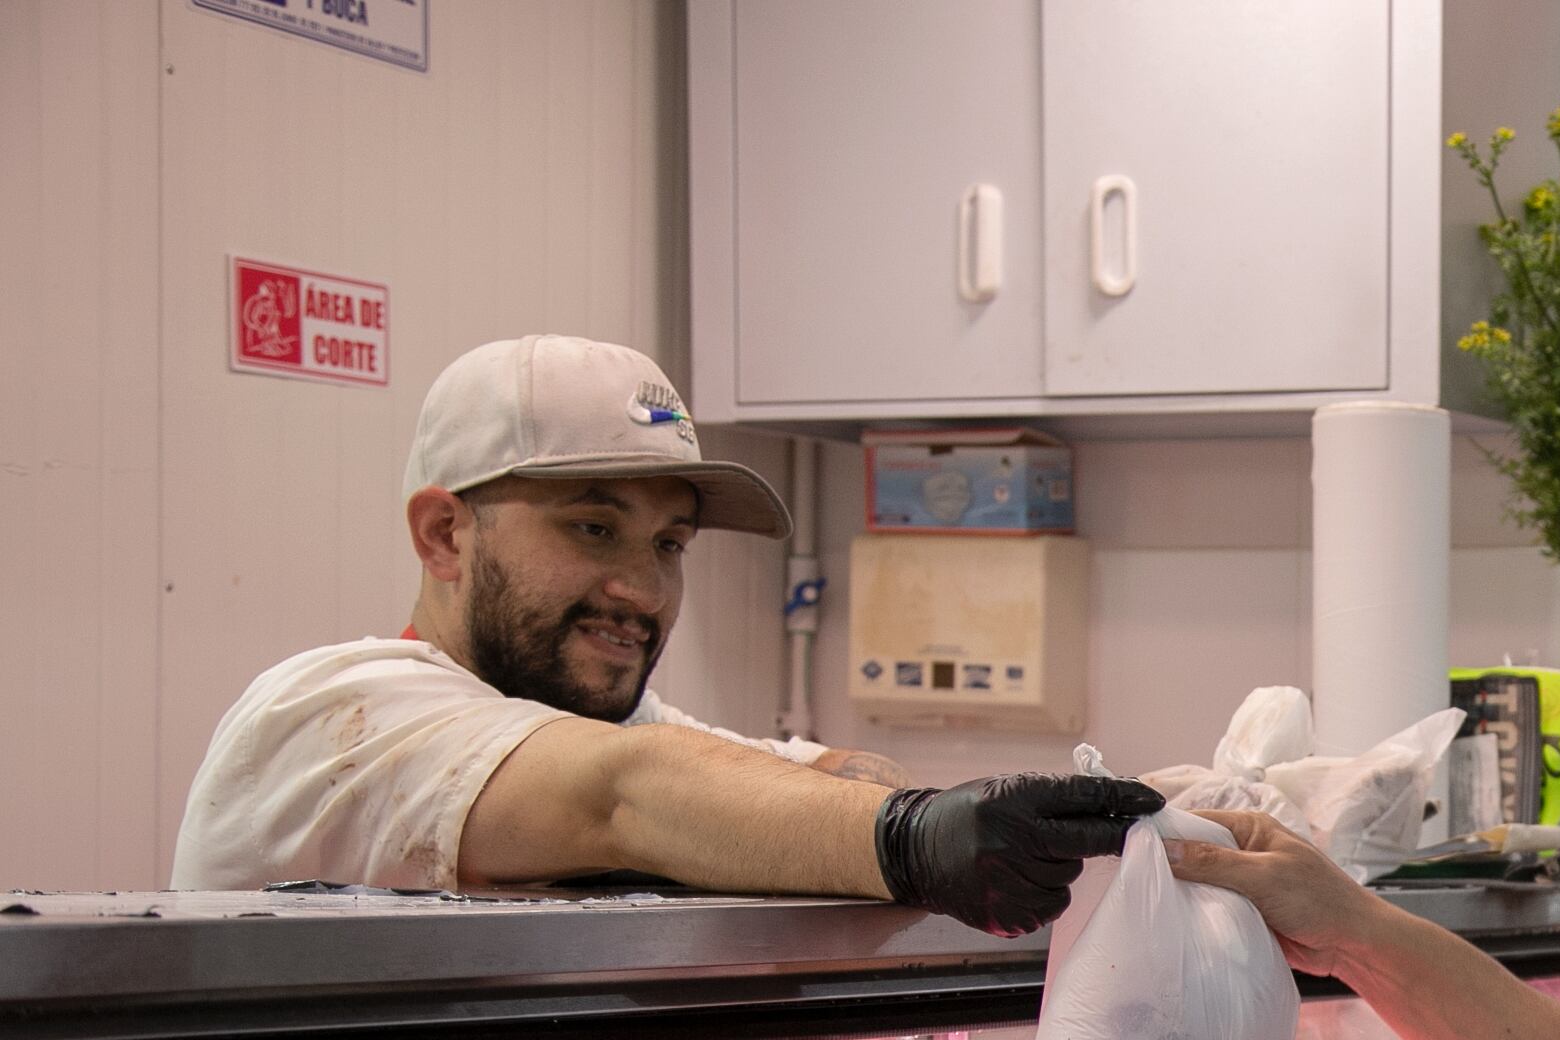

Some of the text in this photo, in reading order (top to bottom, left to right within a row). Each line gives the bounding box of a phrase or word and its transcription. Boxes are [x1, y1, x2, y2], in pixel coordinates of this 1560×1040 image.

[306, 283, 383, 329] ÁREA DE
[313, 334, 376, 372] CORTE
